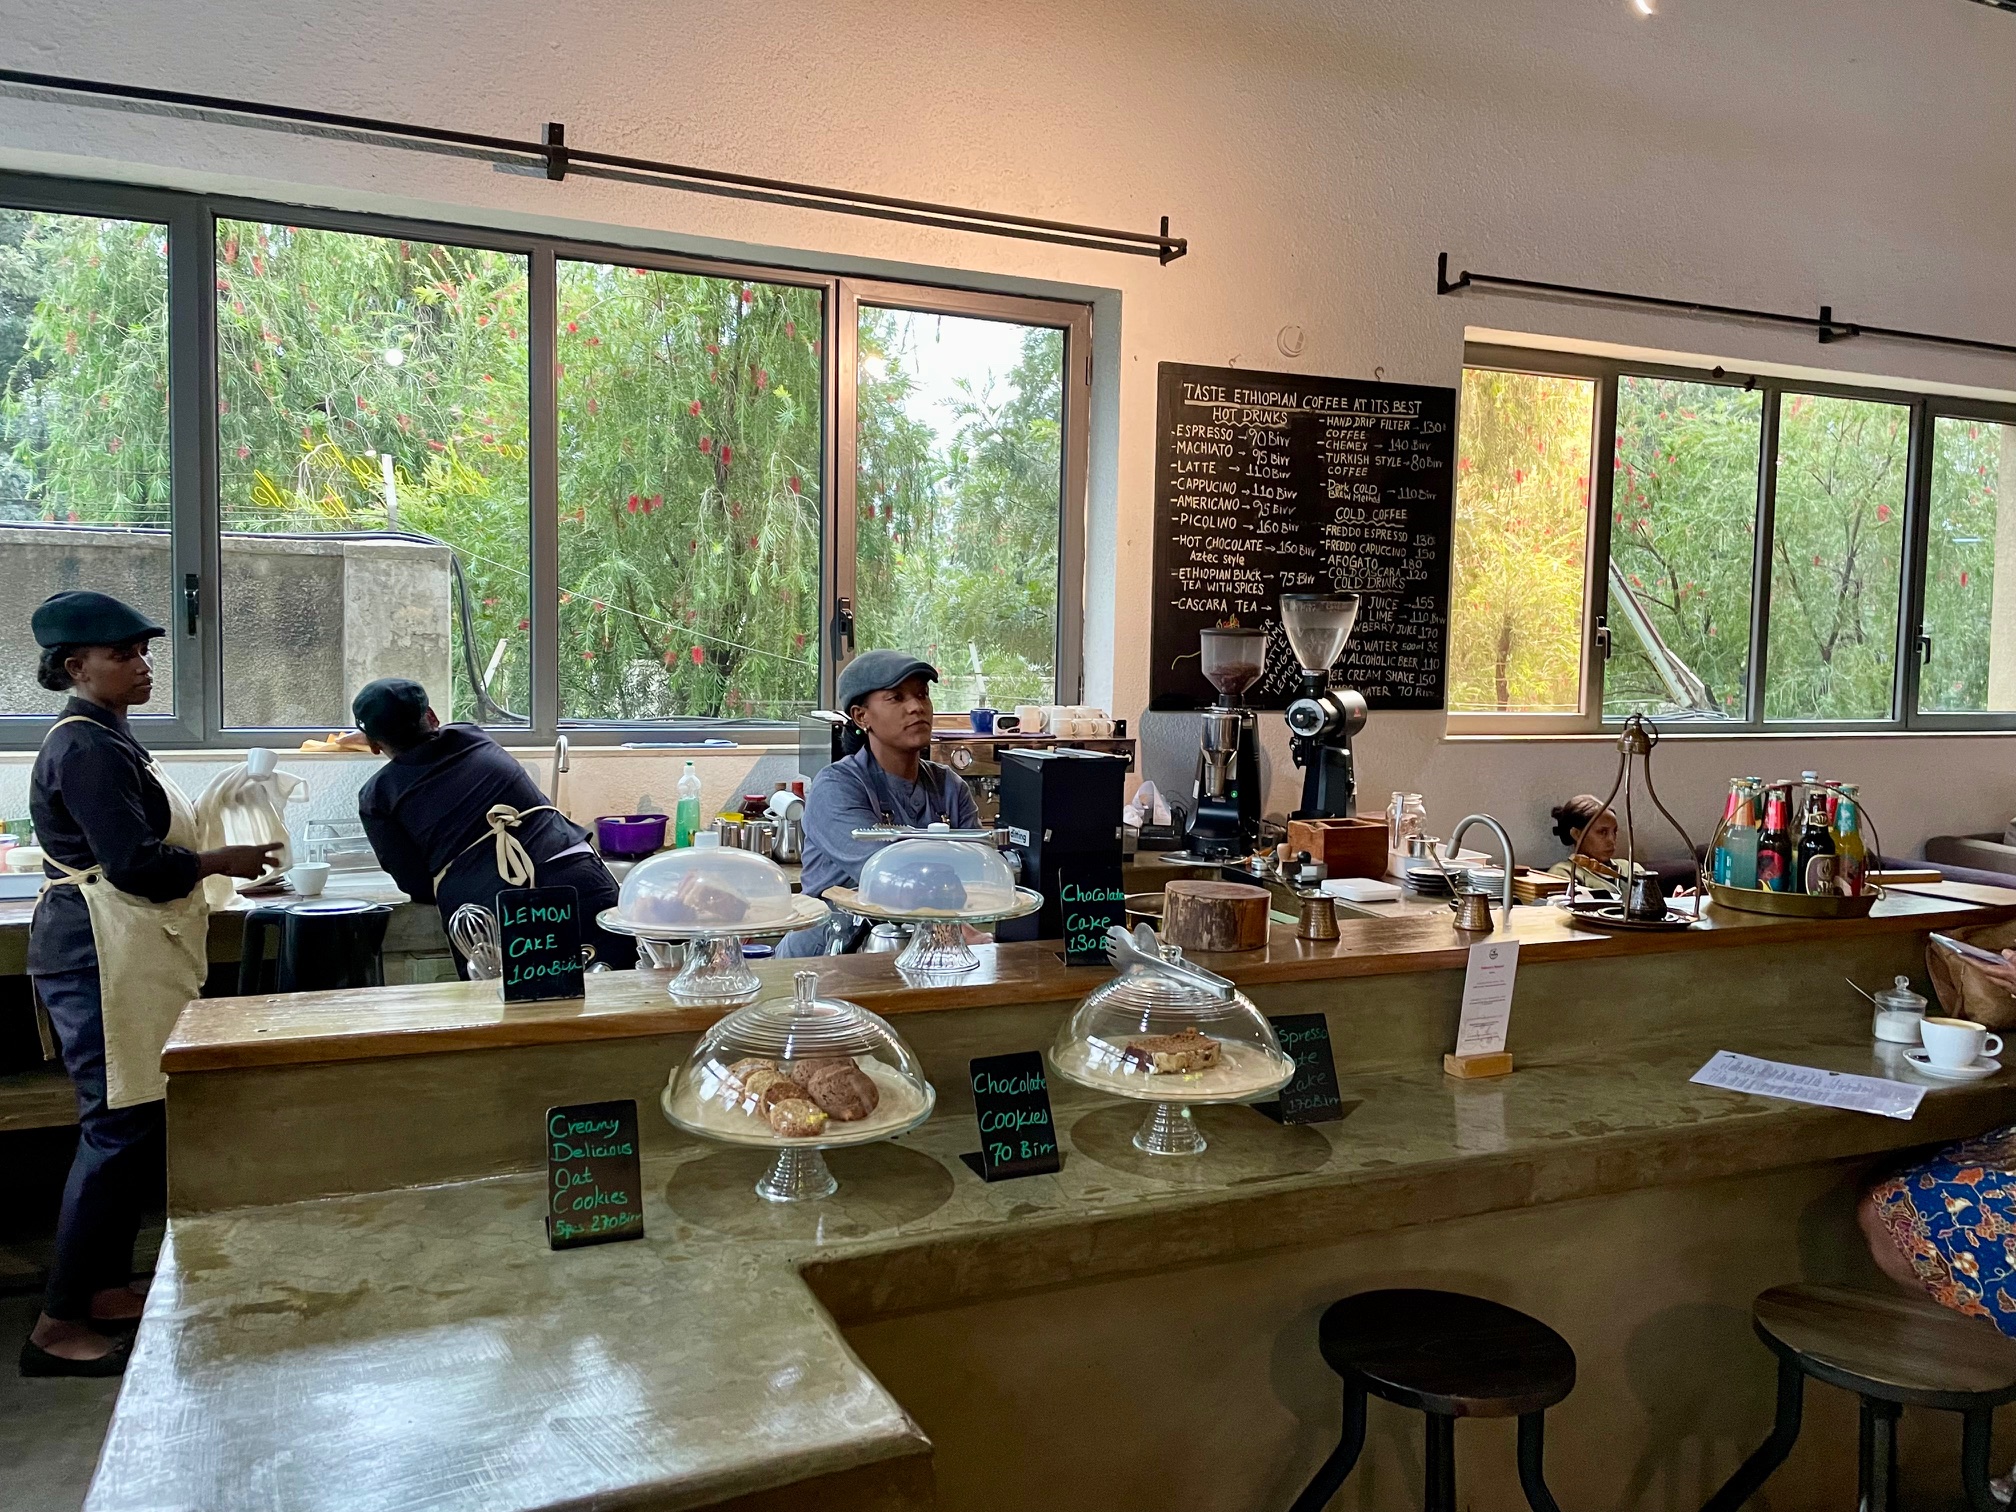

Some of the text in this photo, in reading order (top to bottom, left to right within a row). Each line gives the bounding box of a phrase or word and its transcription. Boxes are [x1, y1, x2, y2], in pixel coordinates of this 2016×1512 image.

[1183, 383, 1422, 414] TASTE ETHIOPIAN COFFEE AT ITS BEST
[1212, 407, 1288, 424] HOT DRINKS
[1326, 416, 1352, 427] HAND
[1353, 417, 1376, 428] DRIP
[1380, 419, 1410, 431] FILTER
[1176, 424, 1291, 447] ESPRESSO 90 Birr
[1326, 429, 1366, 439] COFFEE
[1176, 441, 1290, 466] MACHIATO 95 Birr
[1325, 440, 1368, 451] CHEMEX
[1388, 438, 1409, 451] 140
[1177, 460, 1291, 479] LATTE 110 Birr
[1325, 453, 1369, 465] TURKISH
[1375, 456, 1401, 467] STYLE
[1410, 454, 1425, 471] 80
[1327, 466, 1368, 477] COFFEE
[1177, 477, 1298, 500] CAPPUCINO 110 Birr
[1353, 483, 1377, 494] COLD
[1398, 487, 1417, 499] 110
[1177, 495, 1296, 518] AMERICANO 95 Birr
[1335, 507, 1407, 520] COLD COFFEE
[1180, 512, 1299, 534] PICOLINO 160 Birr
[1325, 524, 1361, 537] FREDDO
[1364, 528, 1408, 542] ESPRESSO
[1180, 534, 1317, 557] HOT CHOCOLATE 160 Birr
[1325, 539, 1435, 559] FREDDO CAPUCCINO 150
[1189, 550, 1245, 567] Aztec style
[1327, 554, 1422, 570] AFOGATO 180
[1178, 566, 1315, 587] ETHIOPIAN BLACK 75 Birr
[1328, 567, 1427, 580] COLD CASCARA 120
[1181, 580, 1264, 595] TEA WITH SPICES
[1334, 577, 1405, 590] COLD DRINKS
[1178, 597, 1257, 613] CASCARA TEA
[1367, 596, 1399, 610] JUICE
[1411, 596, 1435, 609] 155
[1369, 610, 1394, 622] LIME
[1409, 611, 1428, 623] 110
[1418, 627, 1438, 639] 170
[1363, 640, 1398, 652] WATER
[1263, 647, 1292, 692] MANGO
[1347, 653, 1395, 667] ALCOHOLIC
[1398, 656, 1418, 669] BEER
[1421, 658, 1440, 671] 110
[1347, 669, 1381, 681] CREAM
[1385, 670, 1414, 684] SHAKE
[1416, 674, 1436, 686] 150
[1398, 686, 1412, 697] 70
[502, 904, 571, 926] LEMON
[1066, 913, 1110, 932] Cake
[509, 934, 558, 958] CAKE
[507, 965, 546, 985] 100
[550, 1115, 619, 1138] Creamy
[980, 1106, 1048, 1132] Cookies
[551, 1141, 633, 1162] Delicious
[989, 1142, 1012, 1166] 70
[555, 1166, 593, 1189] Oat
[553, 1185, 627, 1214] Cookies
